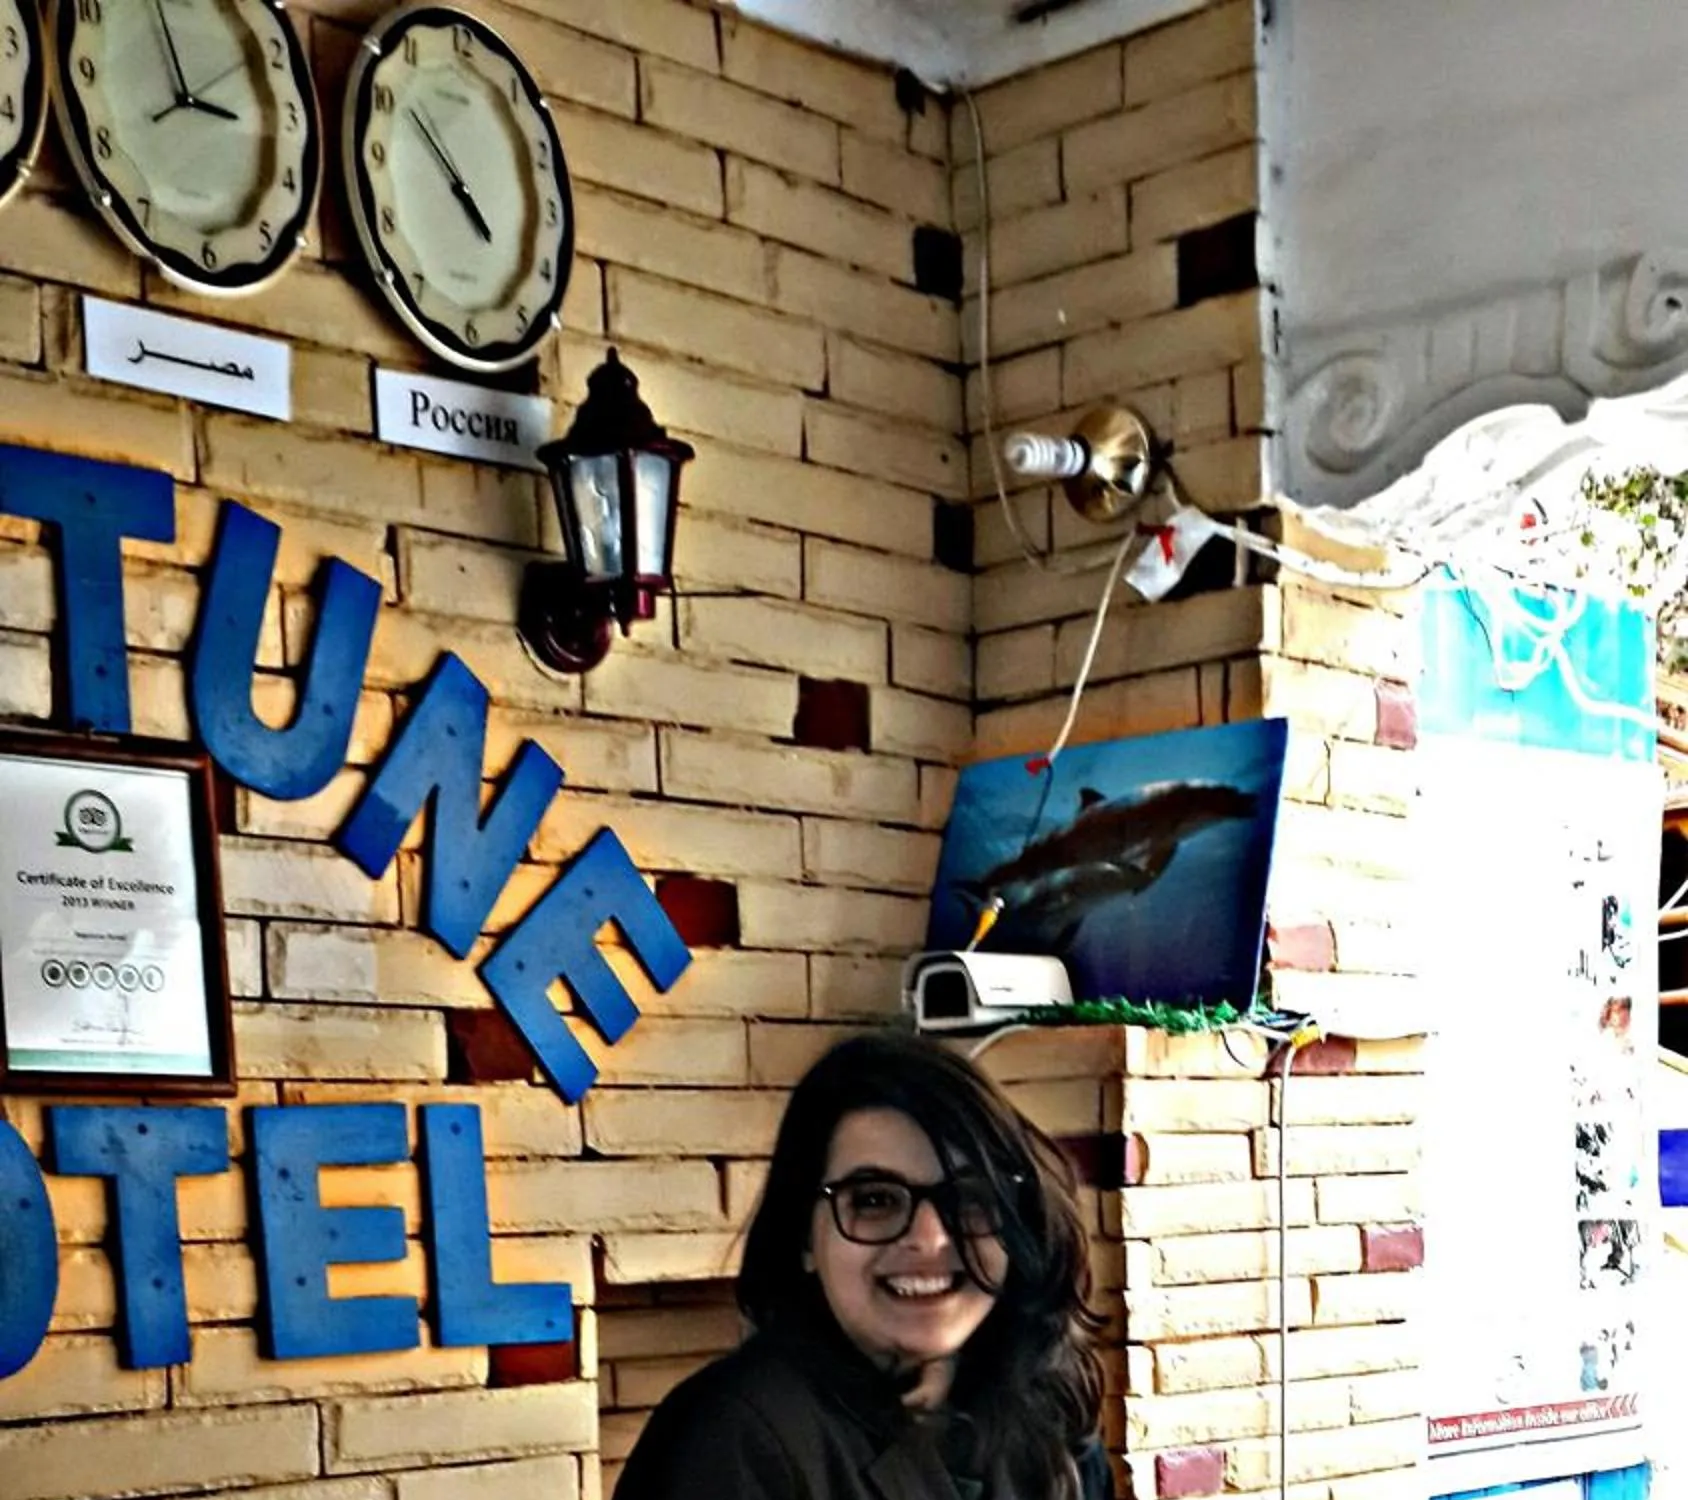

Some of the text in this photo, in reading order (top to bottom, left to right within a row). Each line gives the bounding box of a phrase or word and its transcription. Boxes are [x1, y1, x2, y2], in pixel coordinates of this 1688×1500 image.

[5, 25, 18, 58] 3
[270, 37, 284, 70] 2
[404, 34, 417, 67] 11
[453, 25, 473, 58] 12
[80, 58, 96, 86] 9
[374, 84, 395, 116] 10
[285, 102, 298, 132] 3
[97, 127, 112, 160] 8
[371, 143, 386, 171] 9
[539, 141, 548, 170] 2
[282, 166, 296, 194] 4
[137, 197, 151, 229] 7
[381, 207, 396, 235] 8
[544, 200, 557, 228] 3
[258, 220, 272, 251] 5
[201, 241, 216, 269] 6
[538, 258, 551, 283] 4
[413, 273, 425, 302] 7
[465, 319, 479, 345] 6
[515, 305, 528, 335] 5
[128, 340, 255, 381] مصر
[410, 389, 520, 445] Россия
[0, 444, 694, 1106] TUNE
[17, 870, 175, 895] Certificate of Excellence
[62, 895, 136, 911] 2013 WINNER
